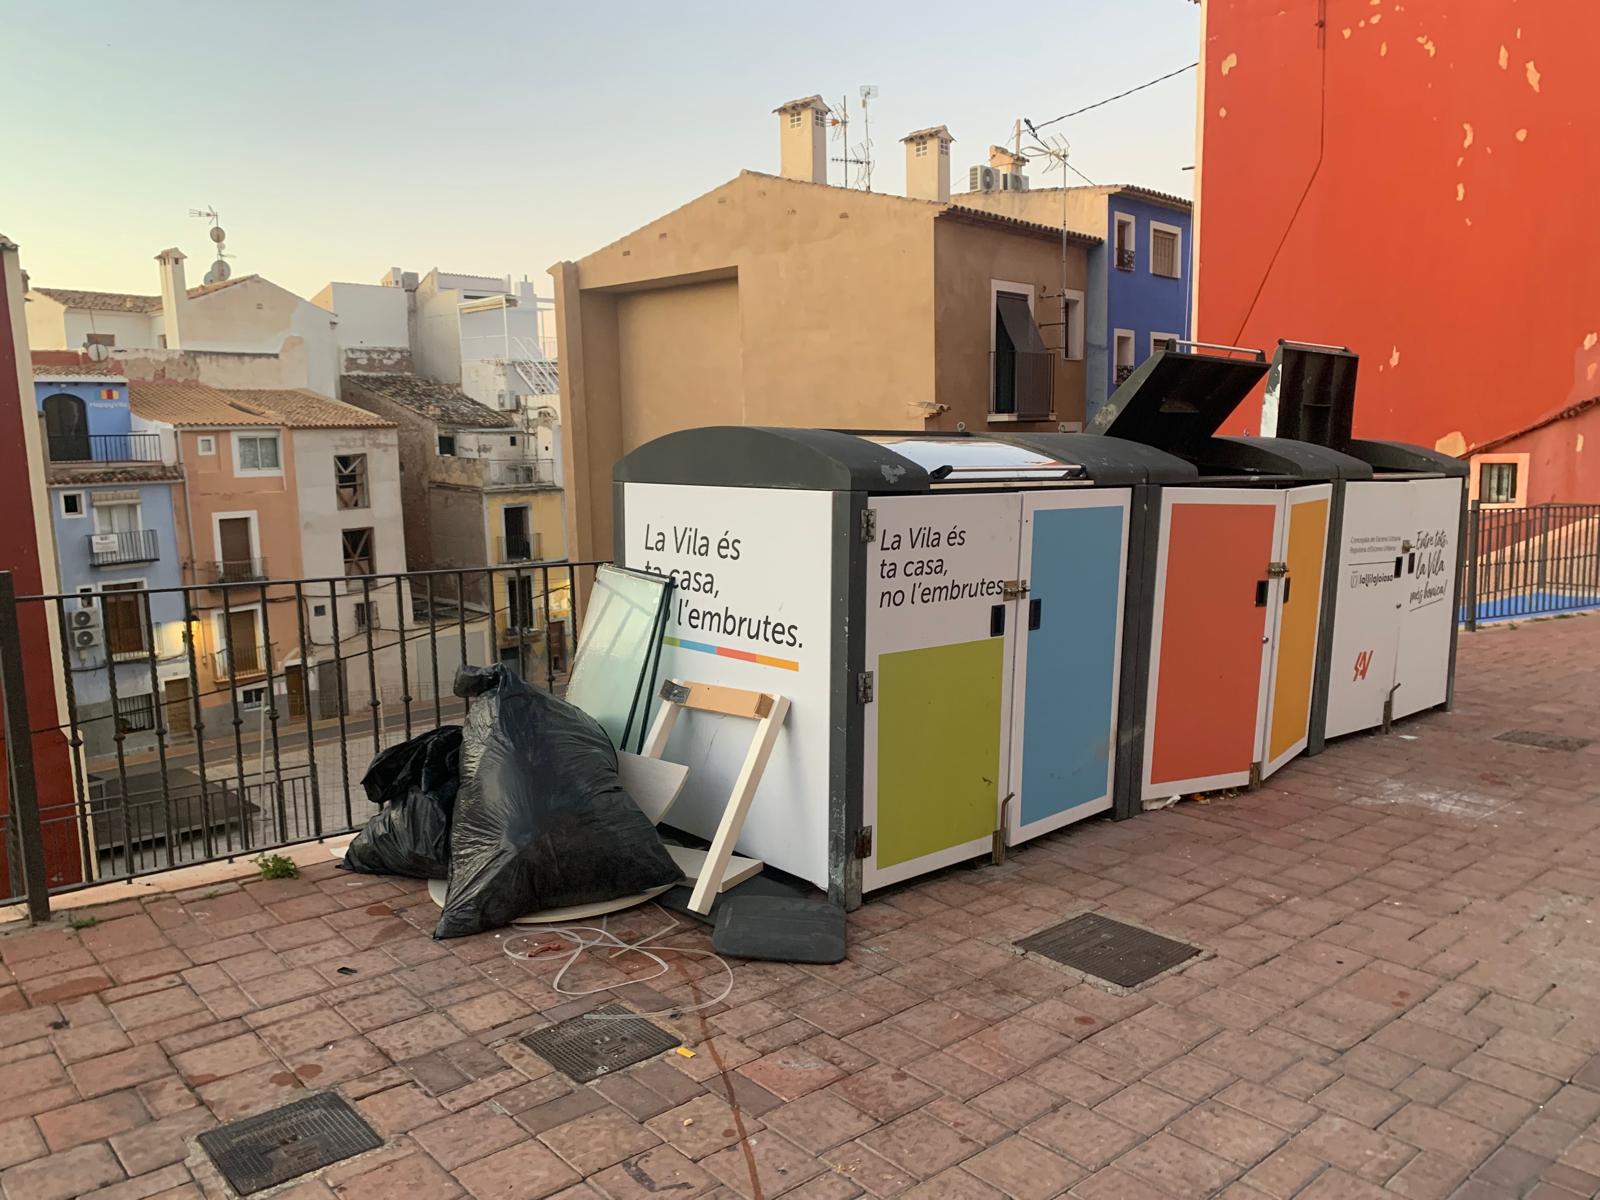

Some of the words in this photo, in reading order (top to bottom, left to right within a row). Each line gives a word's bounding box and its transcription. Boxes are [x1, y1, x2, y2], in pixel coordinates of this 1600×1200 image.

[645, 524, 666, 552] La
[674, 526, 710, 557] Vila
[717, 531, 741, 560] és
[880, 529, 901, 551] La
[909, 526, 941, 549] Vila
[947, 525, 966, 547] és
[880, 559, 897, 579] ta
[903, 558, 948, 577] casa,
[1427, 549, 1444, 578] Vila
[669, 568, 719, 598] casa,
[879, 589, 905, 608] no
[677, 598, 803, 648] l'embrutes.
